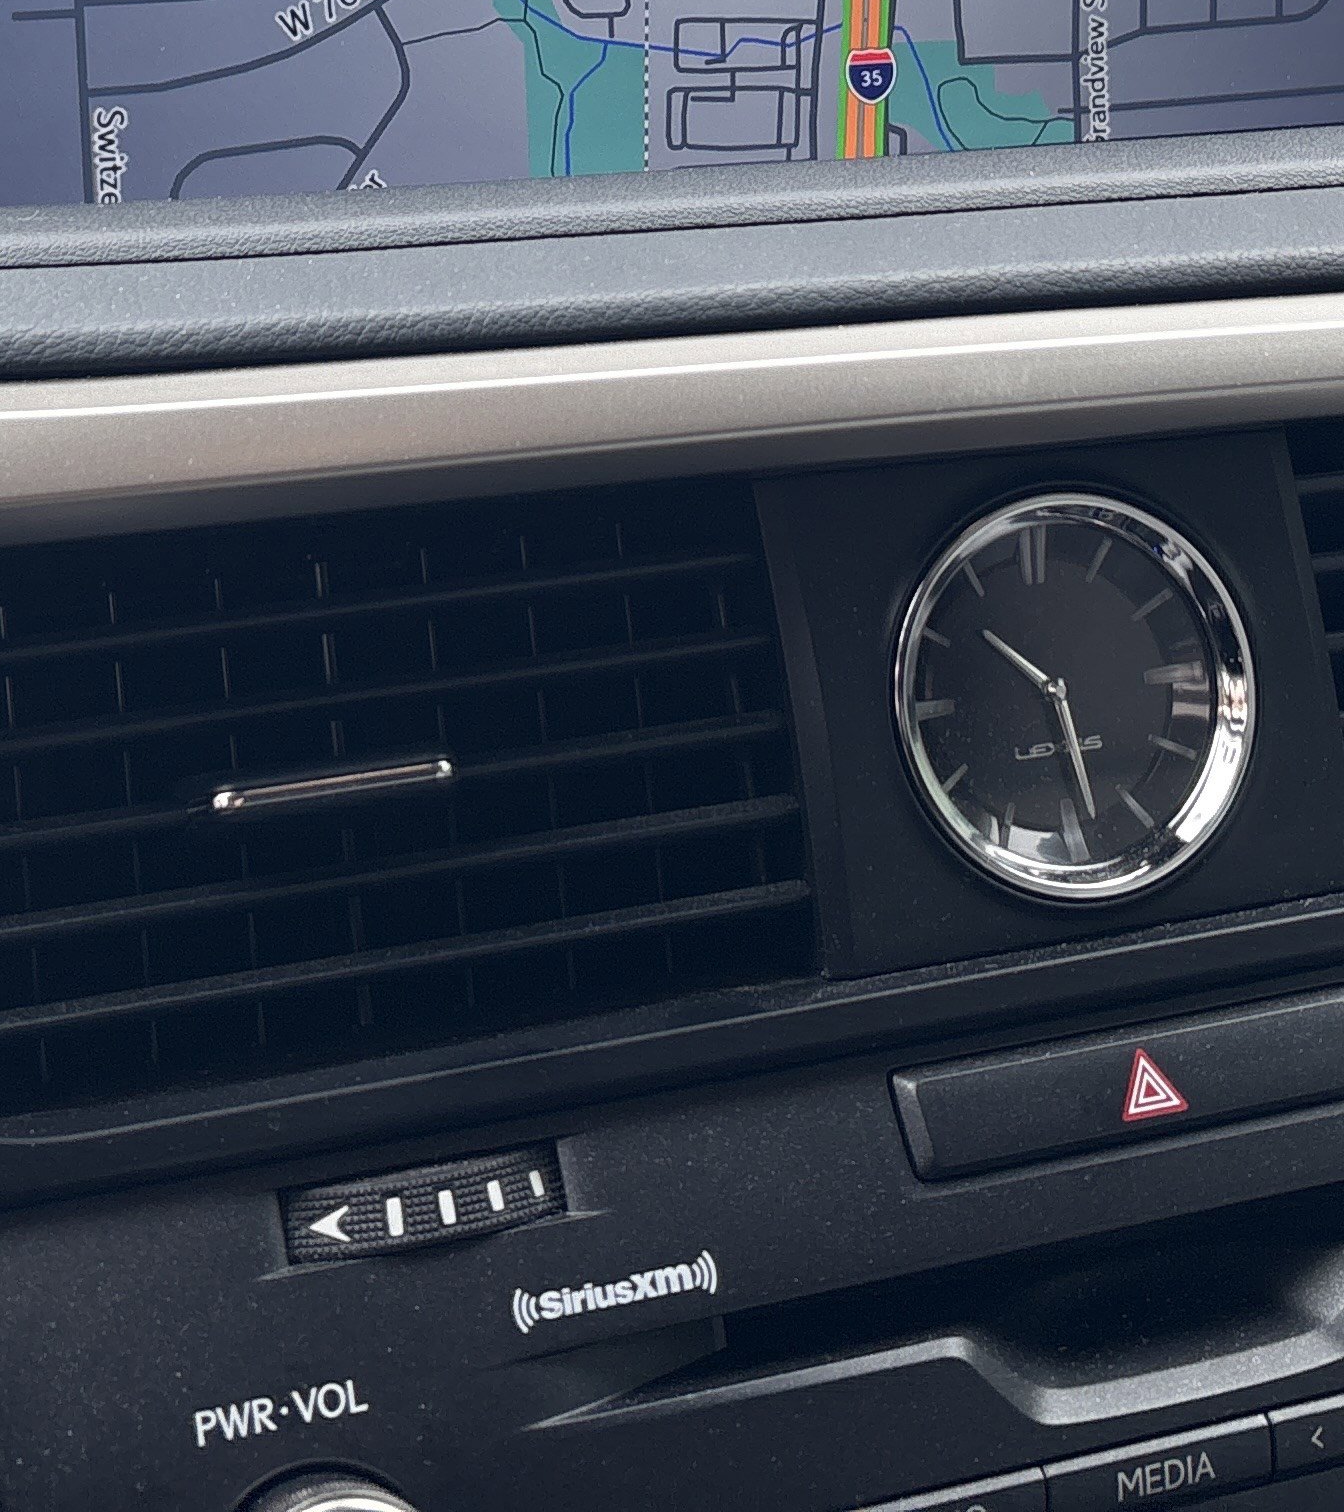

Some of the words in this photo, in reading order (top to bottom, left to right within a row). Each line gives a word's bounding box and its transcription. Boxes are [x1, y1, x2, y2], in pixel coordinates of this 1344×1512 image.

[277, 3, 312, 39] W
[861, 70, 882, 86] 35
[1083, 17, 1106, 142] randview
[1015, 734, 1103, 761] LES
[1116, 1451, 1216, 1504] MEDIA
